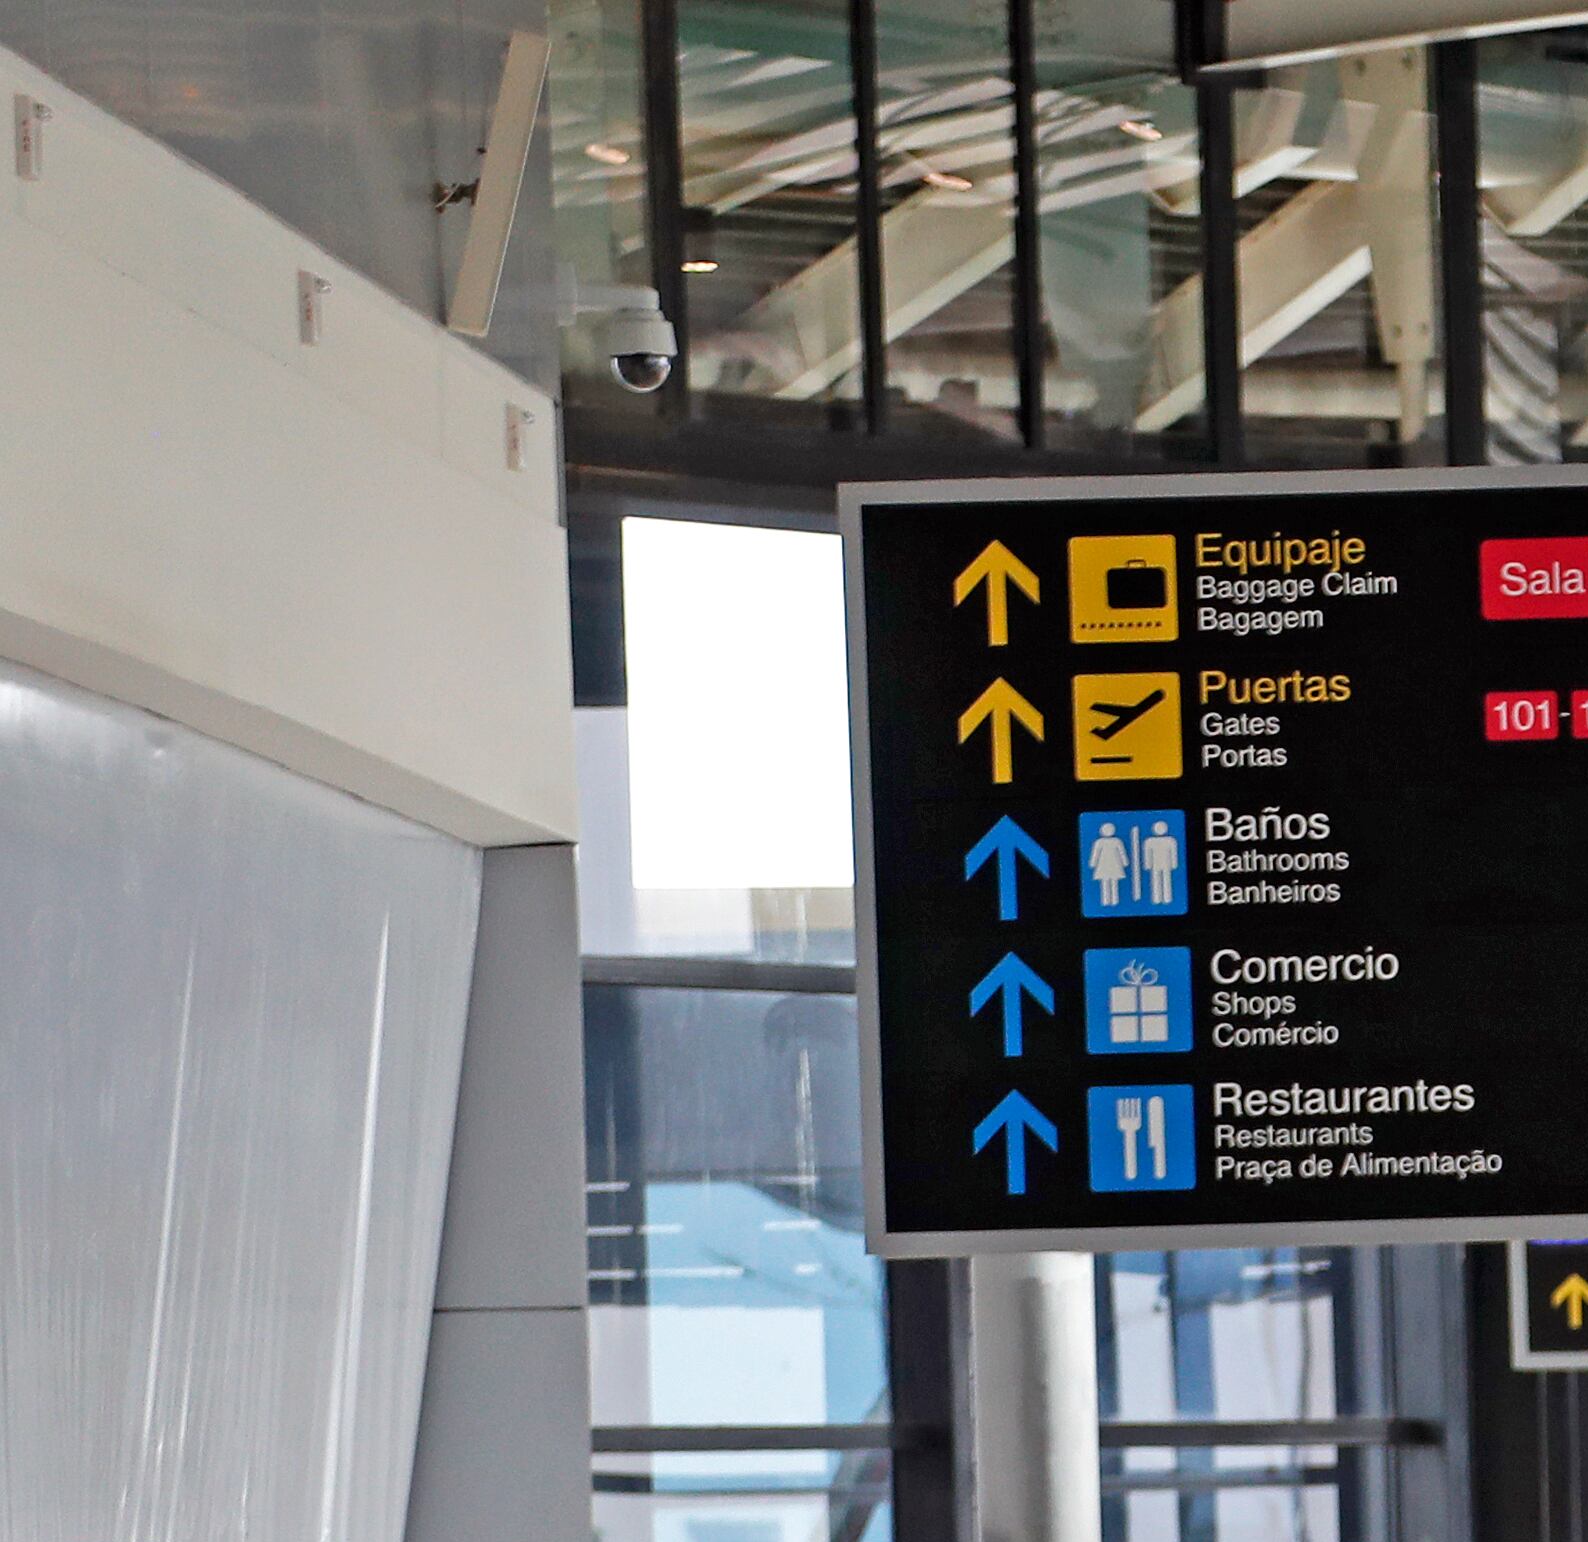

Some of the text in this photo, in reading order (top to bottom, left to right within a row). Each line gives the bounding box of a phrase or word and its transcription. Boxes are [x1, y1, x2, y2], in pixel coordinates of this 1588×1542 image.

[1197, 531, 1366, 569] Equipaje
[1198, 565, 1398, 605] Baggage Claim
[1501, 561, 1586, 596] Sala
[1198, 605, 1324, 636] Bagagem
[1201, 671, 1351, 704] Puertas
[1201, 712, 1281, 737] Gates
[1202, 744, 1288, 768] Portas
[1206, 807, 1331, 842] Baños
[1207, 848, 1350, 873] Bathrooms
[1208, 880, 1341, 905] Banheiros
[1211, 946, 1399, 984] Comercio
[1213, 992, 1297, 1019] Shops
[1213, 1019, 1339, 1047] Comércio
[1214, 1080, 1476, 1117] Restaurantes
[1216, 1122, 1374, 1148] Restaurants
[1217, 1149, 1503, 1185] Praça de Alimentação
